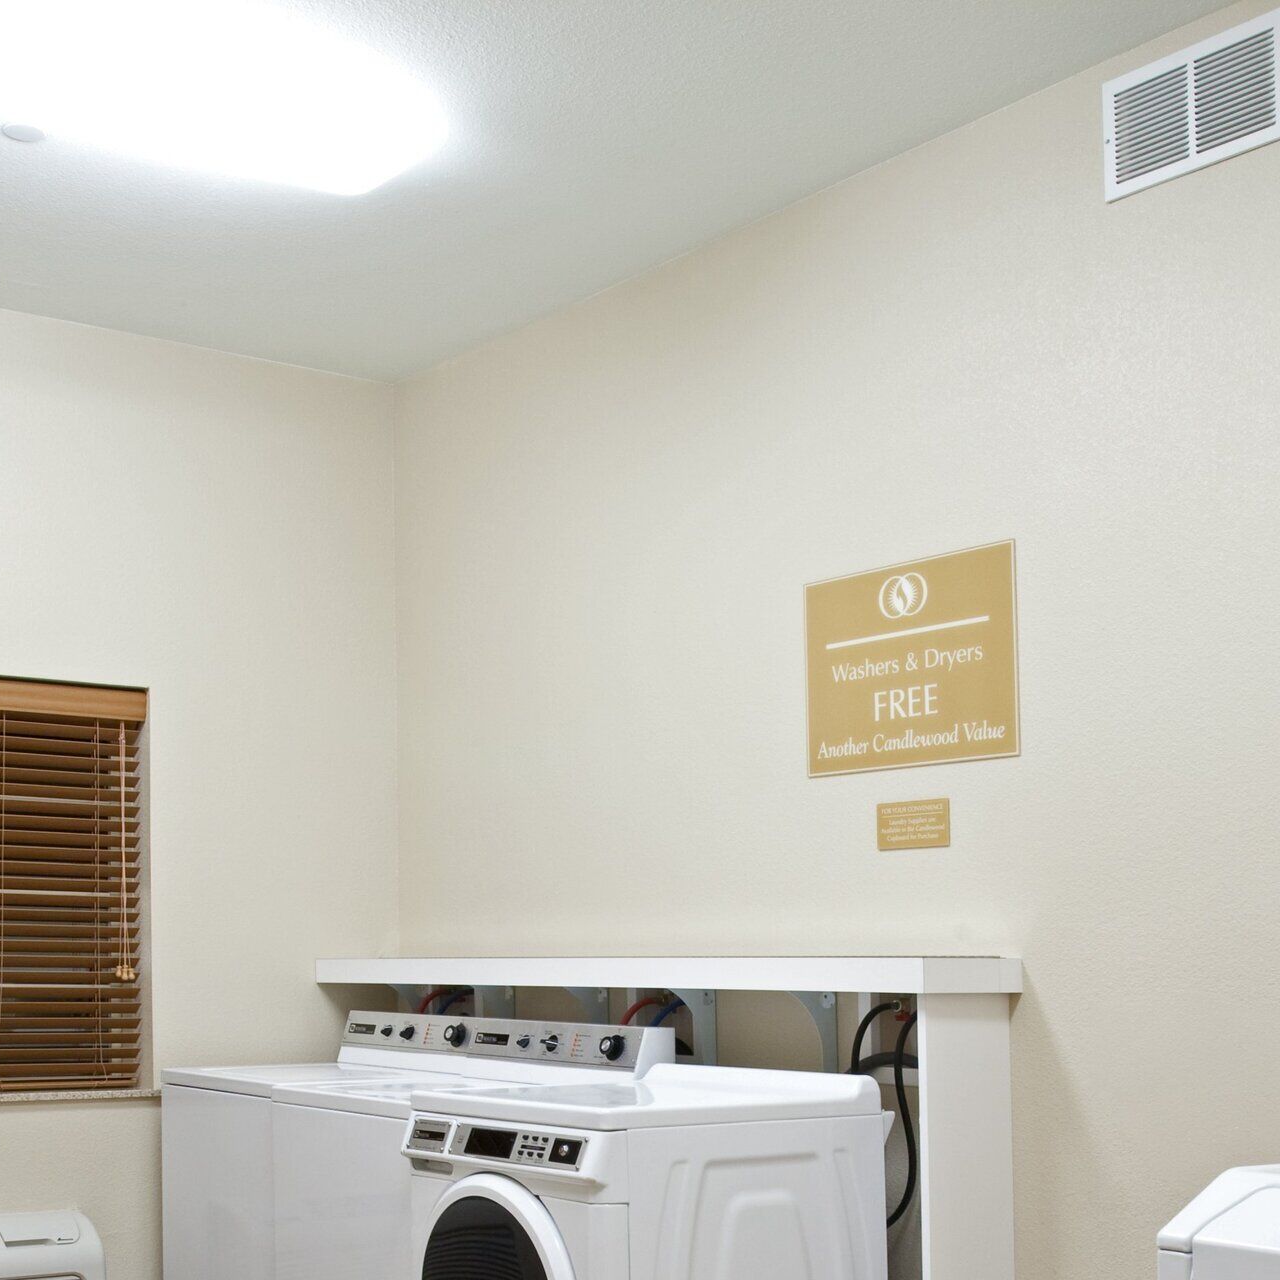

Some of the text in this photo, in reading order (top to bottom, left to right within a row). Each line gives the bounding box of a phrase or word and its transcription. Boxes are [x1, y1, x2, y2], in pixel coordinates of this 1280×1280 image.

[832, 646, 984, 683] Washers & Dryers
[874, 684, 938, 722] FREE
[818, 720, 1006, 760] Another Candlewood Value
